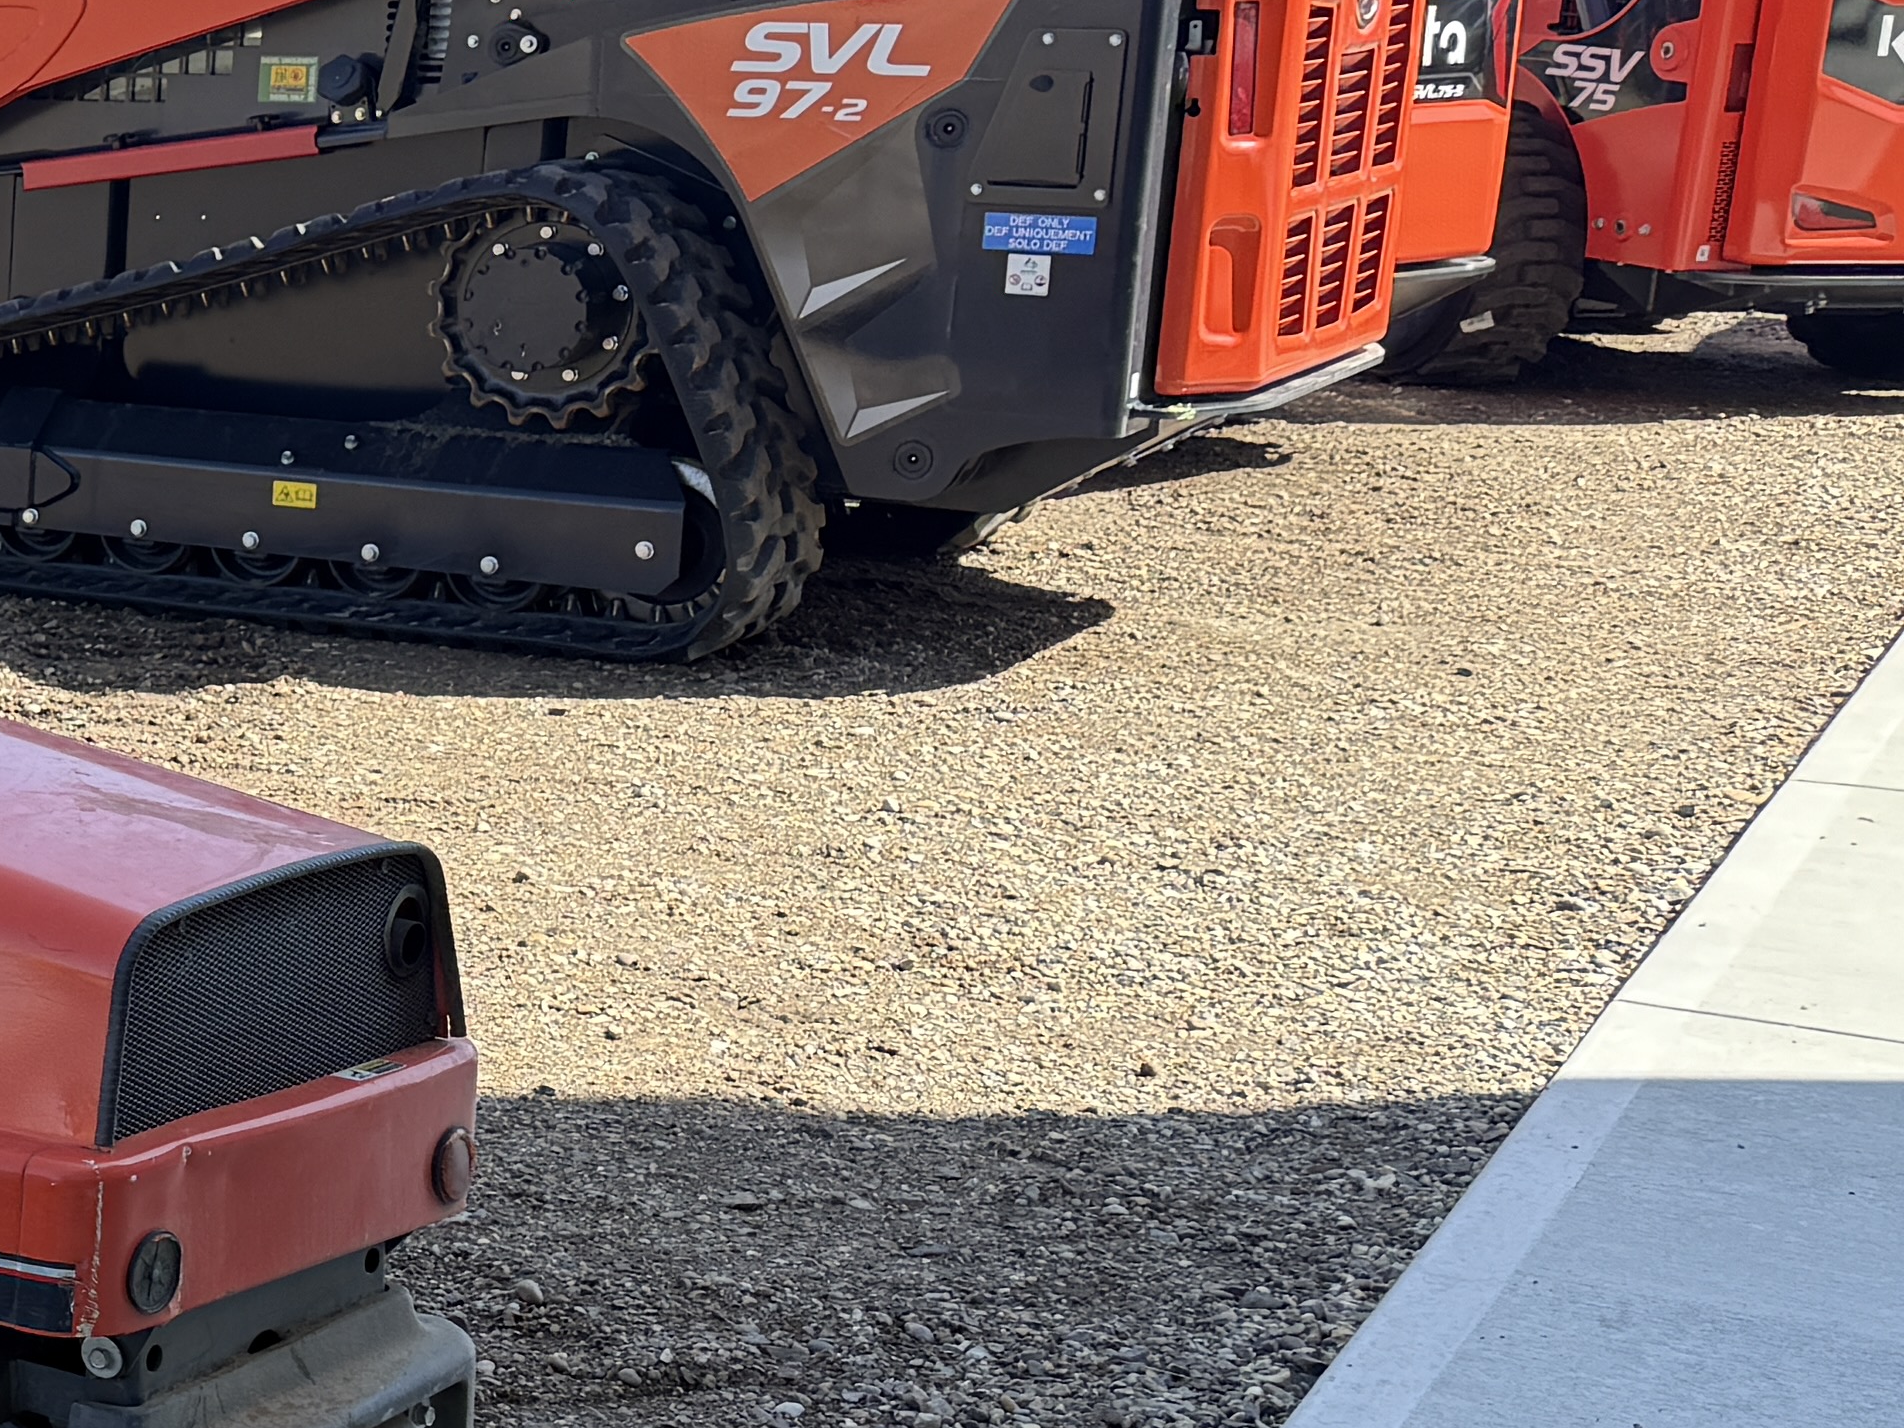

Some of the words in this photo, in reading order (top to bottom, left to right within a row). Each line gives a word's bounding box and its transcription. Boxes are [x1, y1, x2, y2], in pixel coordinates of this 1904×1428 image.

[730, 21, 931, 77] SVL
[1545, 43, 1646, 83] SSV
[726, 78, 868, 121] 97-2
[1568, 80, 1620, 111] 75
[985, 226, 1009, 236] DEF
[1012, 228, 1093, 241] UNIQUEMENT
[1009, 216, 1033, 226] DEF
[1038, 217, 1070, 228] ONLY
[1008, 238, 1040, 249] SOLO
[1043, 240, 1068, 250] DEF
